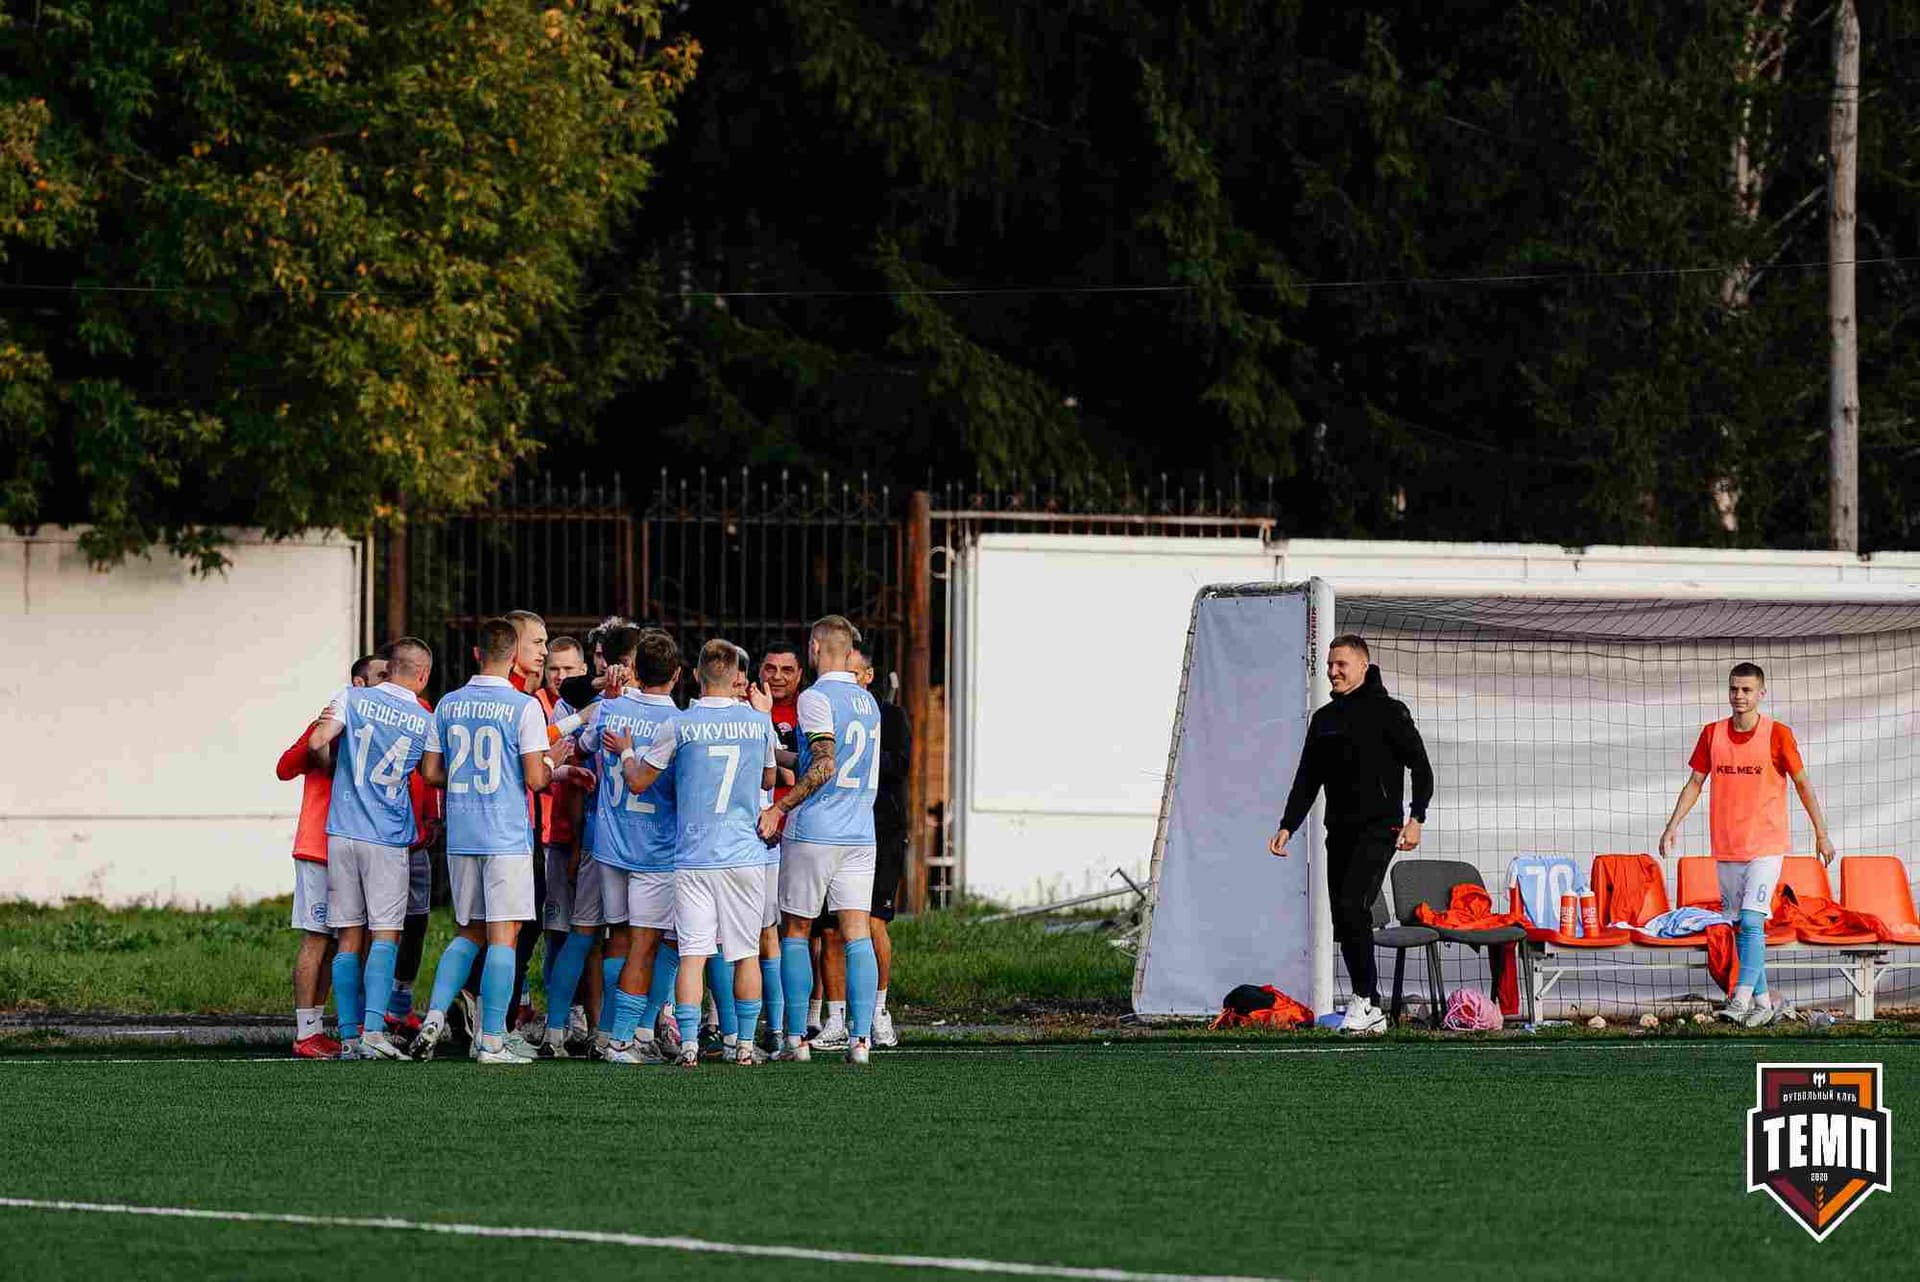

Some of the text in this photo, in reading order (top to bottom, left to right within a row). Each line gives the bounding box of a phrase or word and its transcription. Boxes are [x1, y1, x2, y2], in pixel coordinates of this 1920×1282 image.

[357, 699, 426, 735] ПЕЩЕРОВ
[680, 721, 765, 743] КУКУШКИН
[354, 723, 413, 800] 14
[447, 725, 501, 795] 29
[708, 745, 740, 814] 7
[837, 720, 881, 790] 21
[1716, 765, 1754, 775] KELME
[1525, 864, 1574, 924] 70
[1756, 883, 1768, 903] 6
